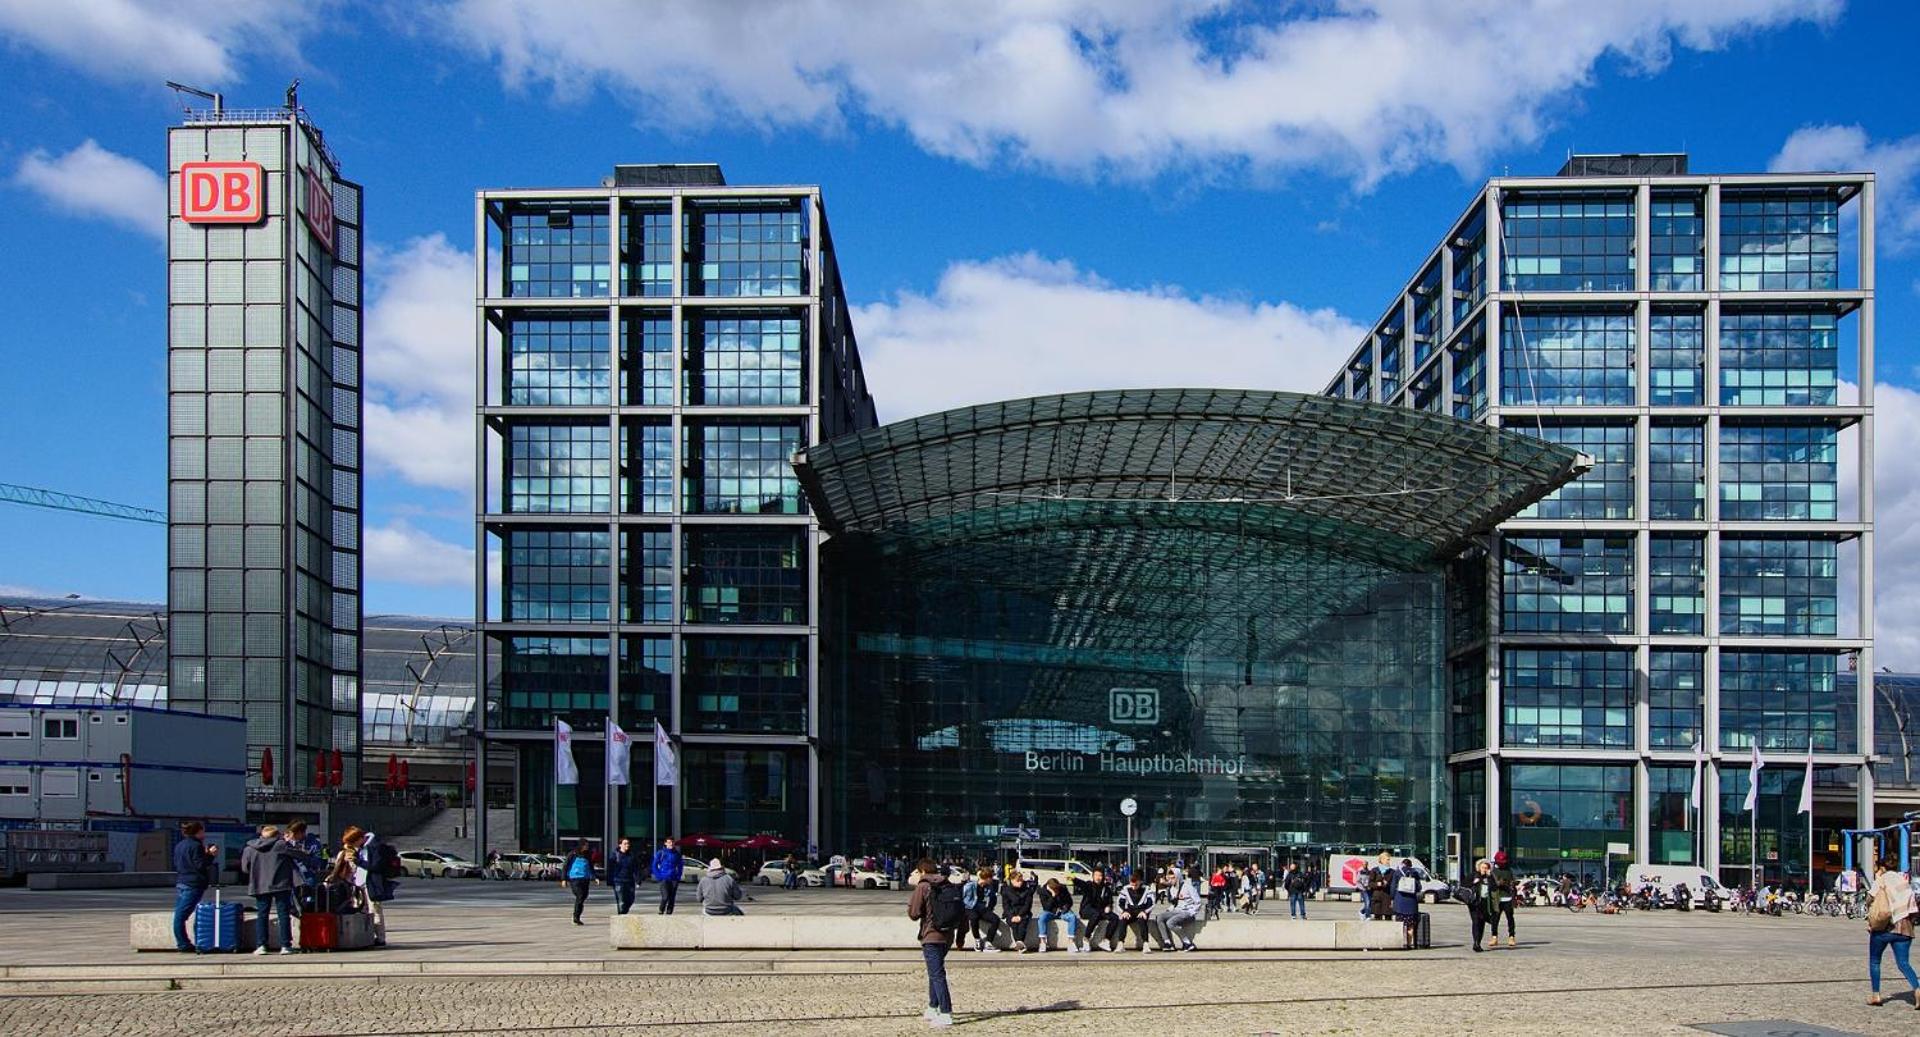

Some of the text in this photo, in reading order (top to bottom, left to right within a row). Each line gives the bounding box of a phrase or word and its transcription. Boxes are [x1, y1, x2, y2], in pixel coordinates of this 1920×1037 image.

[191, 172, 251, 212] DB
[311, 193, 331, 241] DB
[1115, 692, 1154, 719] DB
[1025, 750, 1246, 776] Berlin Hauptbahnhof
